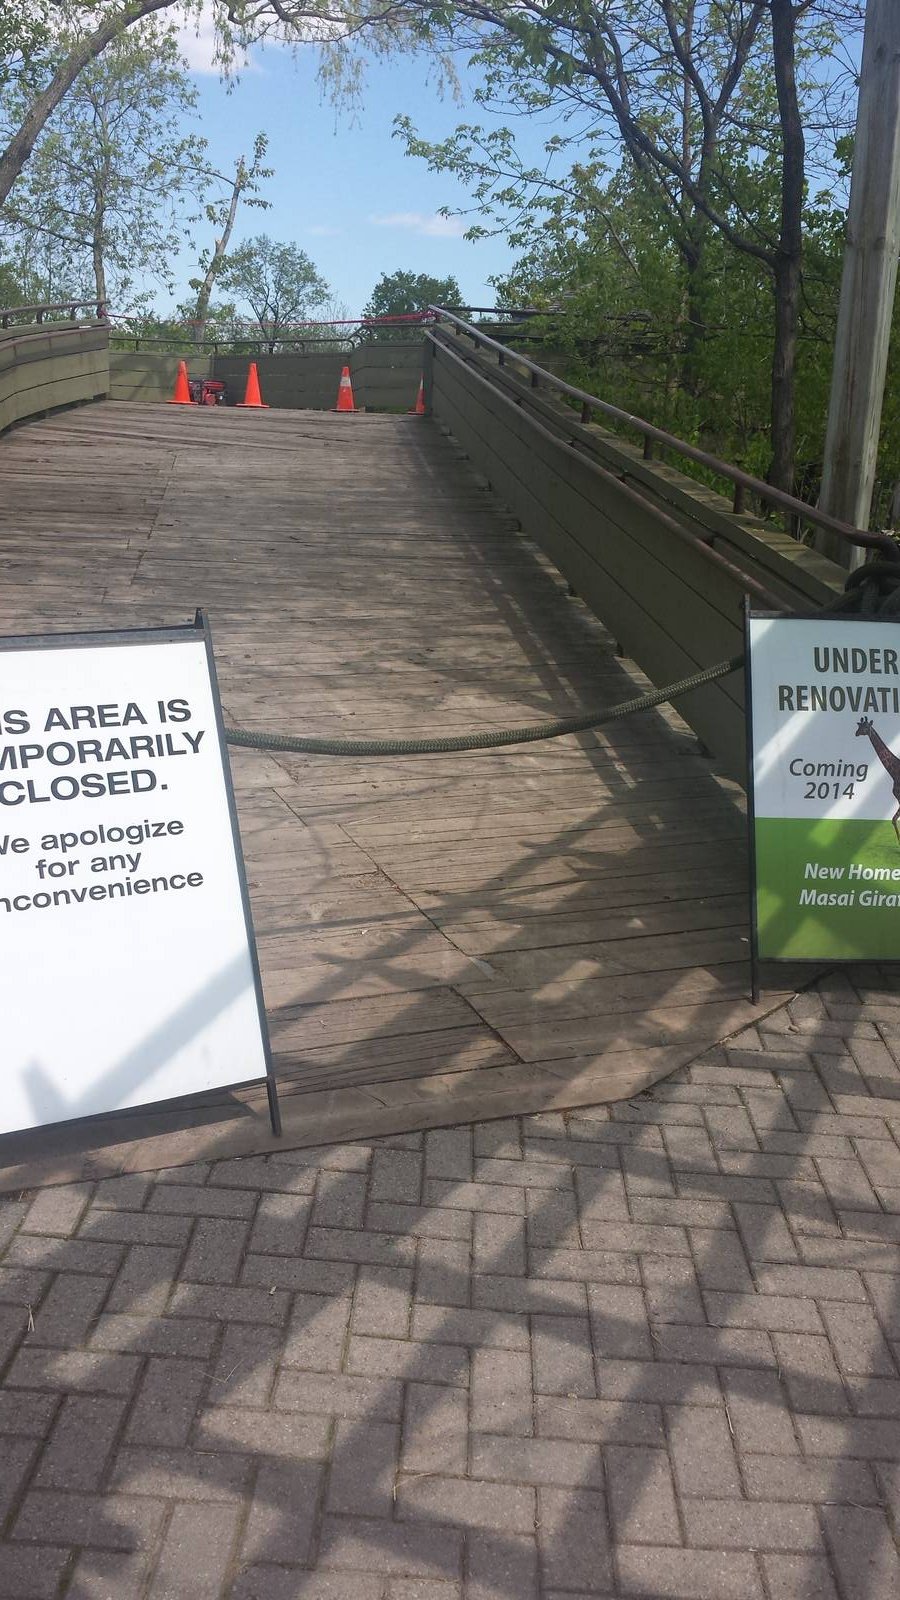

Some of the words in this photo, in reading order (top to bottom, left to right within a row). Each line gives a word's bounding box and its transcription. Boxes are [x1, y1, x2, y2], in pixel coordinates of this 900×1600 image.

[813, 647, 899, 675] UNDER
[44, 702, 148, 732] AREA
[157, 698, 192, 723] IS
[789, 758, 869, 782] Coming
[0, 769, 168, 806] CLOSED.
[803, 781, 855, 800] 2014
[40, 819, 184, 854] apologize
[35, 857, 80, 880] for
[90, 852, 142, 873] any
[804, 862, 845, 880] New
[848, 863, 900, 881] Home
[799, 889, 855, 906] Masai
[859, 889, 900, 907] Gira
